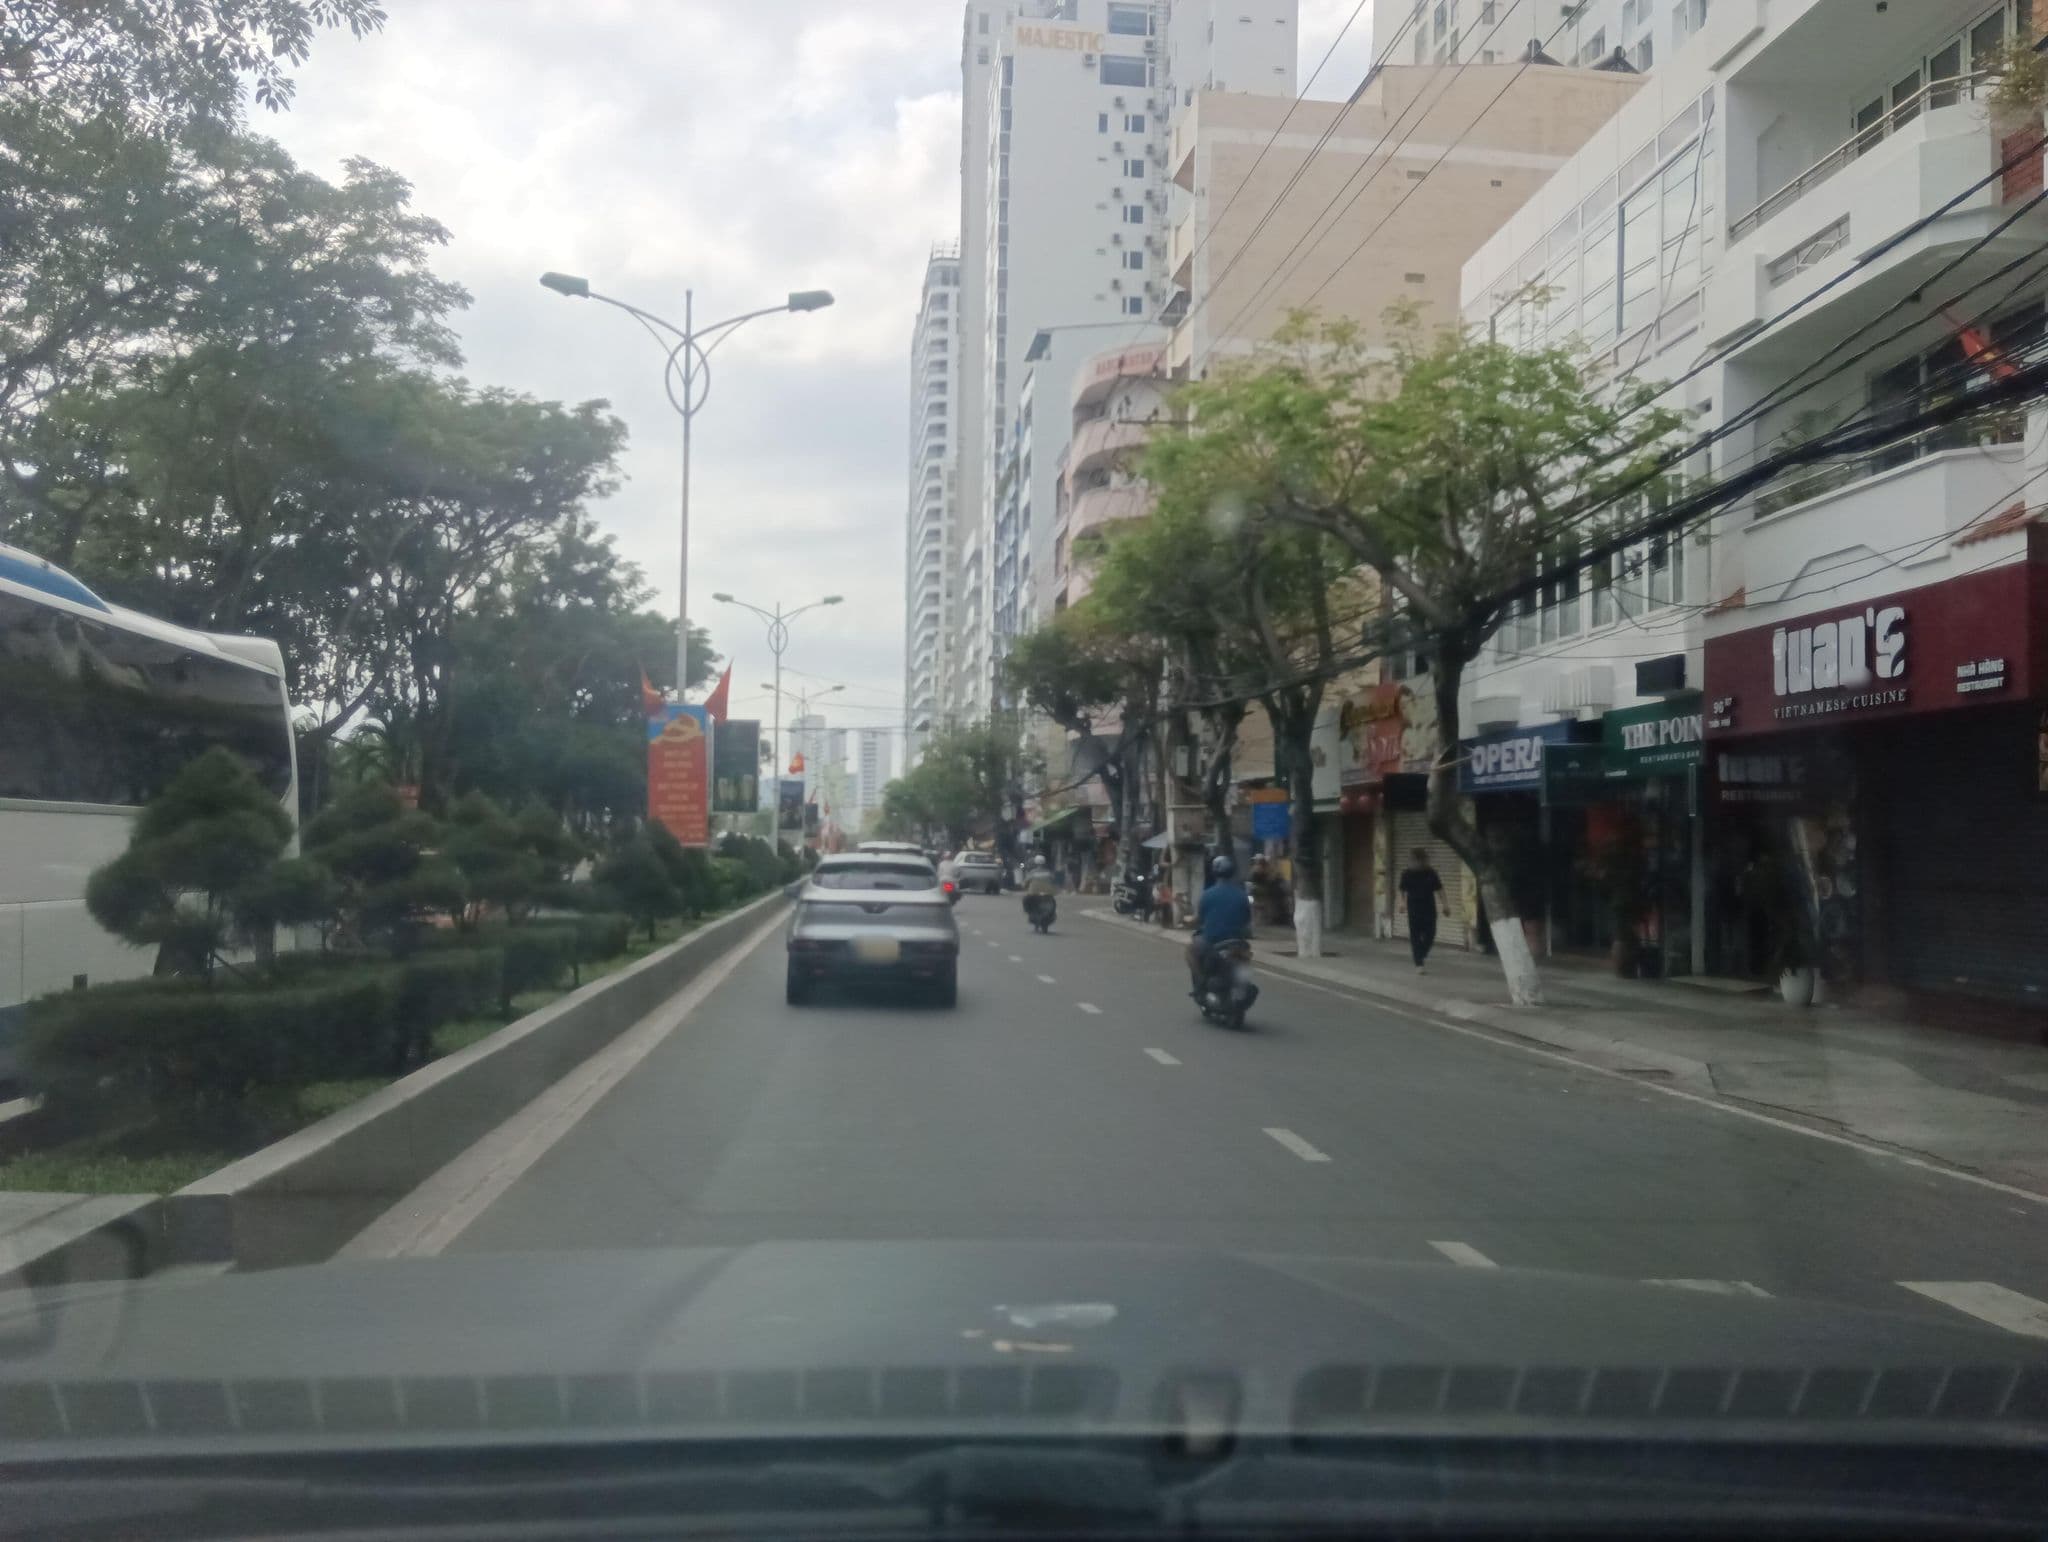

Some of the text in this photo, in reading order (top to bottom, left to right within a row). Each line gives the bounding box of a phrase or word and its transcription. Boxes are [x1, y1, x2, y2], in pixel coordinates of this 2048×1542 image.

[1017, 26, 1105, 52] MAJESTIC
[1774, 689, 1907, 719] VIETNAMESE CUISINE
[1621, 721, 1656, 750] THE
[1471, 735, 1543, 775] OPERA
